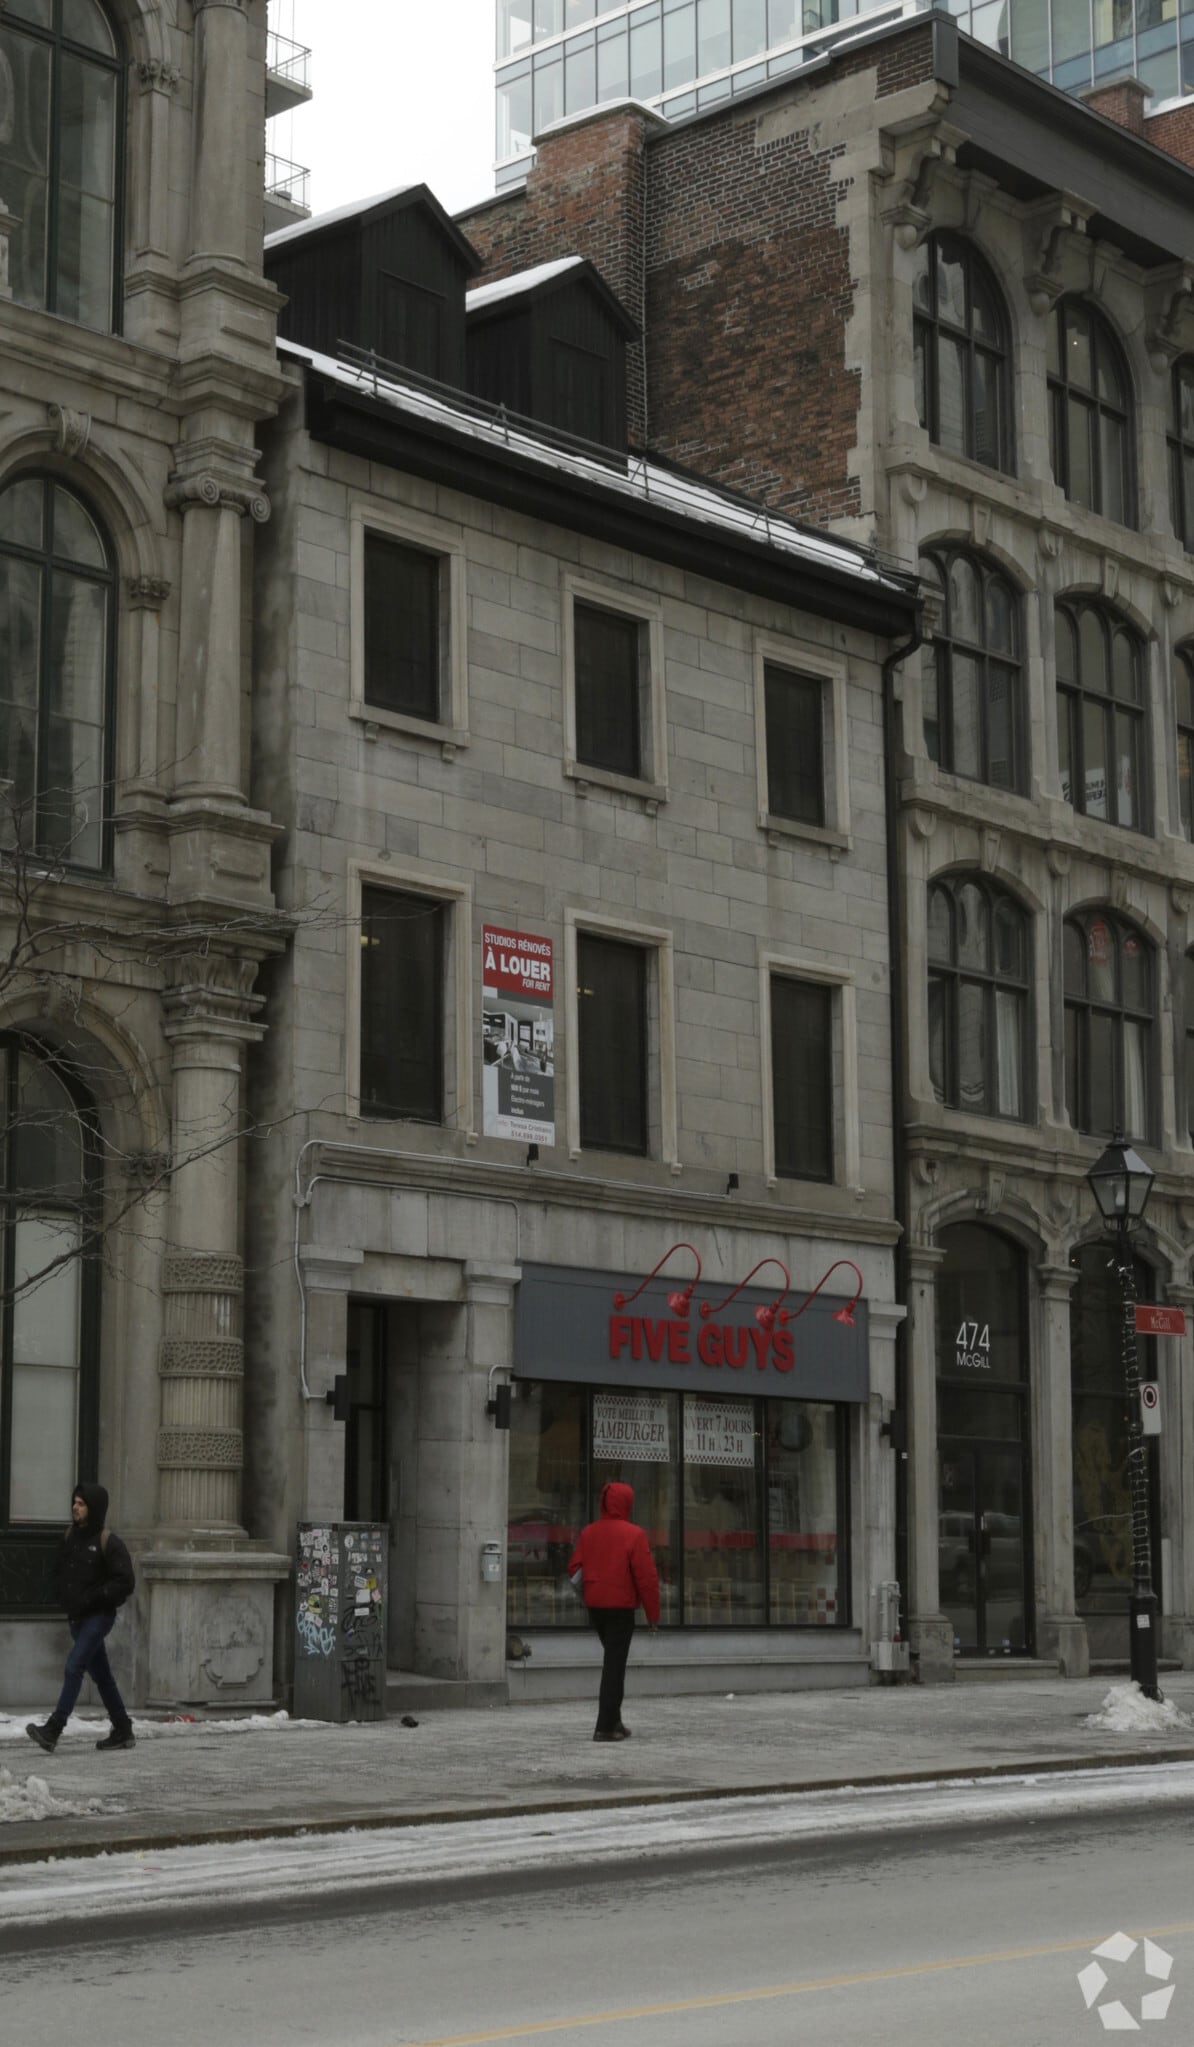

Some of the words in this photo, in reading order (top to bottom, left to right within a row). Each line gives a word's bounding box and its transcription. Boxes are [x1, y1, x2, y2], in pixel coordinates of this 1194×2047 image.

[484, 932, 516, 949] STUDIOS
[518, 939, 551, 957] RÉNOVÉS
[485, 945, 497, 970] À
[500, 953, 550, 982] LOUER
[522, 978, 535, 990] FOR
[535, 980, 550, 992] RENT
[609, 1314, 691, 1363] FIVE
[697, 1322, 794, 1371] GUYS
[956, 1321, 990, 1352] 474
[597, 1407, 616, 1419] VOTE
[619, 1408, 655, 1422] MEILLEUR
